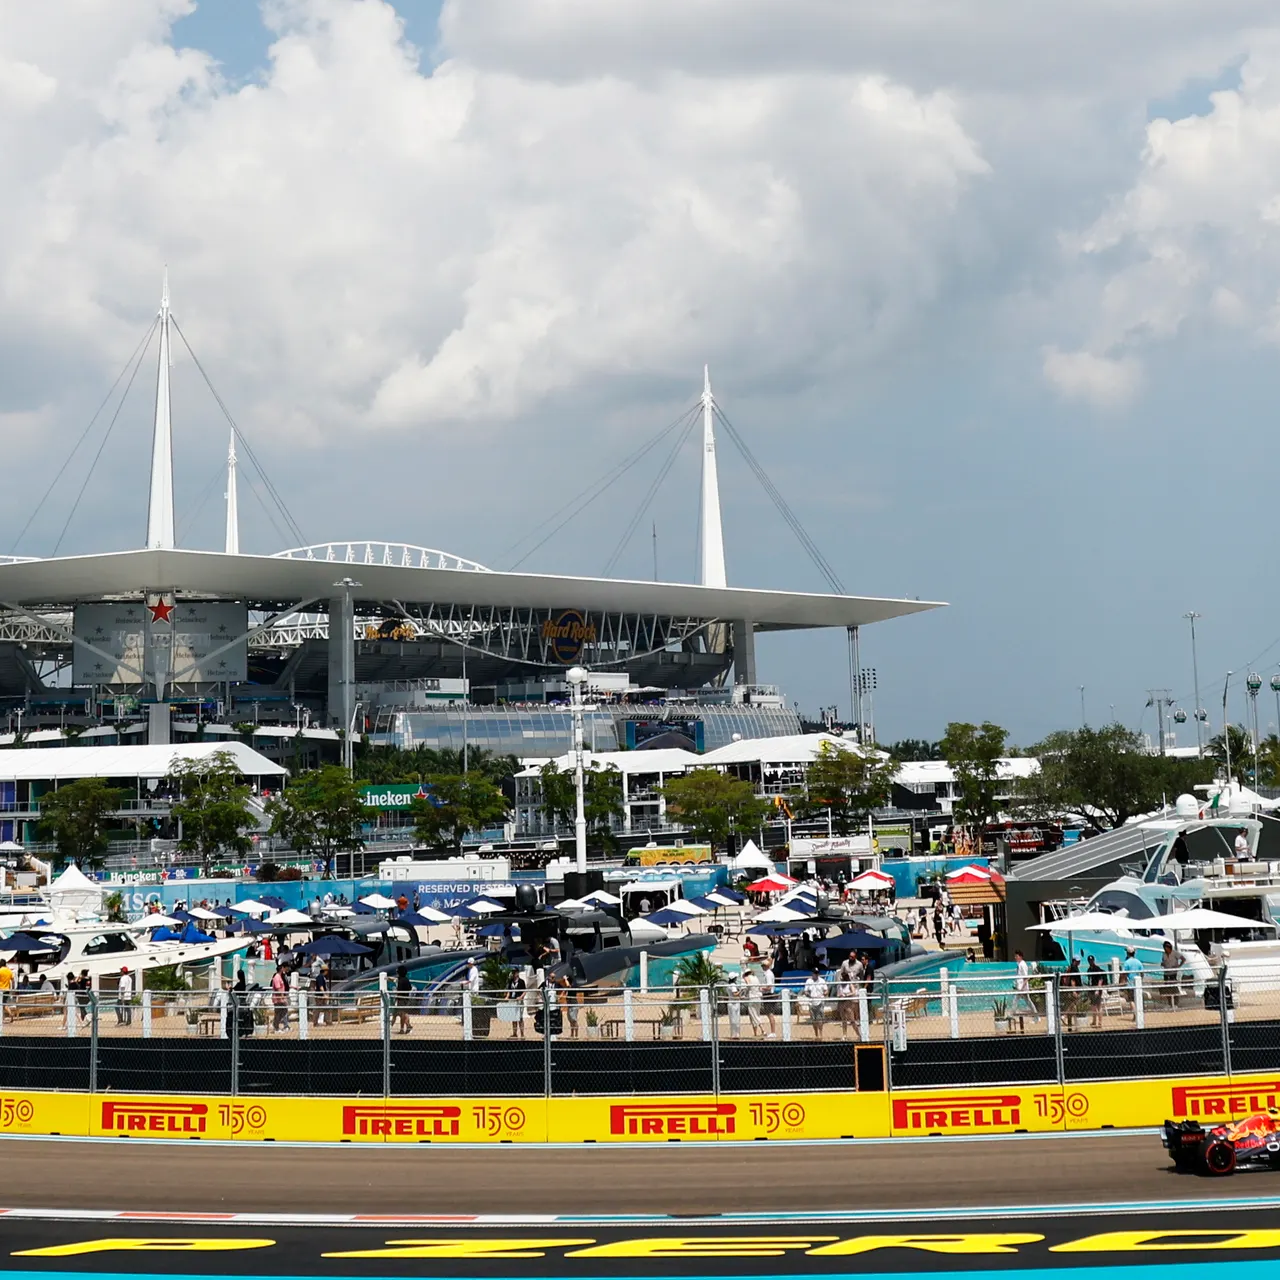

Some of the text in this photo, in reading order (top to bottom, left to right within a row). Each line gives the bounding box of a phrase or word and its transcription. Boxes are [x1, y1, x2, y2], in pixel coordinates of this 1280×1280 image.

[542, 620, 596, 642] Hard Rock
[110, 871, 157, 882] Heineken
[418, 884, 471, 893] RESERVED
[101, 1101, 267, 1135] PIRELLI 150
[342, 1105, 526, 1137] PIRELLI 150
[609, 1102, 806, 1135] PIRELLI 150
[892, 1092, 1090, 1129] PIRELLI 150
[10, 1237, 276, 1257] P
